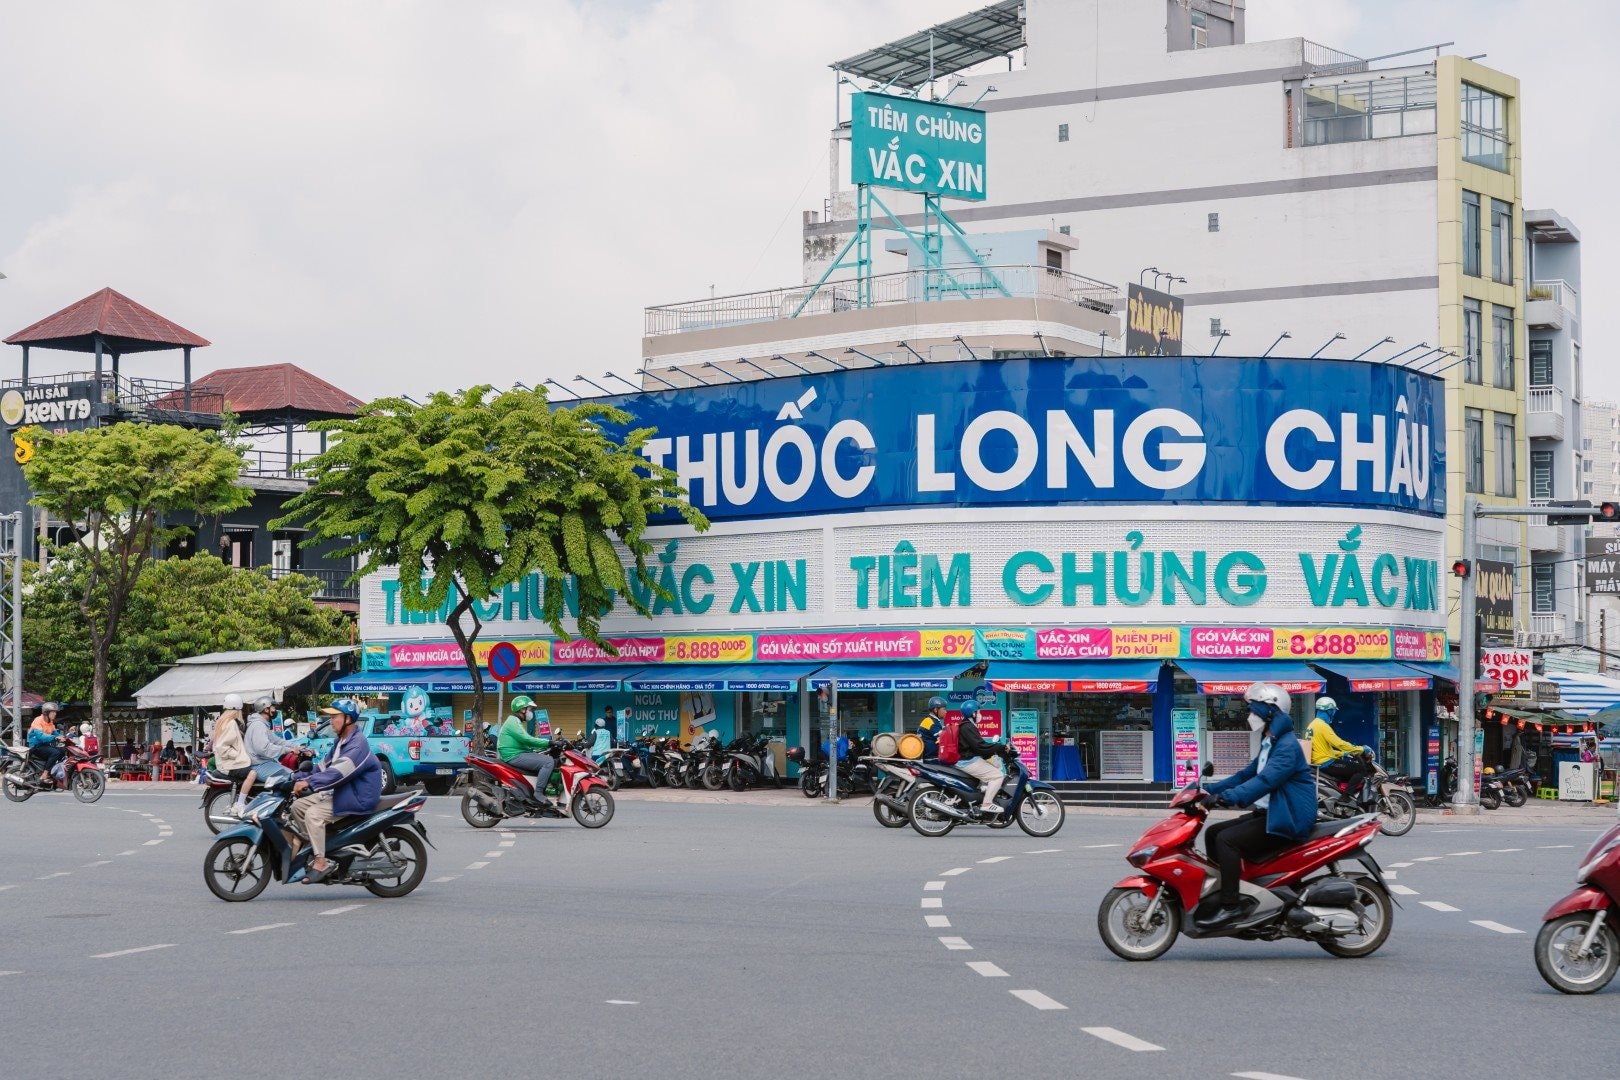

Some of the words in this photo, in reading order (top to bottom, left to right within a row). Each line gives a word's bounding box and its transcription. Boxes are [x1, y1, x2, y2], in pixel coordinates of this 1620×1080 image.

[868, 104, 908, 133] TIÊM
[915, 112, 983, 144] CHỦNG
[868, 135, 926, 184] VẮC
[937, 158, 983, 193] XIN
[642, 385, 877, 507] THUỐC
[917, 407, 1207, 492] LONG
[1265, 394, 1430, 501] CHÂU
[850, 539, 971, 609] TIÊM
[1001, 530, 1268, 607] CHỦNG
[1298, 524, 1399, 608] VẮC
[1404, 555, 1439, 611] XIN
[1588, 559, 1616, 573] MÁY
[627, 538, 715, 616] VẮC
[730, 558, 807, 614] XIN
[1039, 630, 1066, 644] VẮC
[1068, 633, 1090, 643] XIN
[1115, 630, 1148, 643] MIỄN
[1152, 631, 1173, 643] PHÍ
[1196, 631, 1219, 642] GÓI
[1220, 628, 1247, 642] VẮC
[1249, 632, 1270, 641] XIN
[558, 646, 574, 659] GÓI
[575, 643, 593, 659] VẮC
[639, 645, 659, 657] HPV
[761, 641, 778, 655] GÓI
[781, 639, 801, 655] VẮC
[803, 642, 820, 654] XIN
[823, 638, 842, 653] SỐT
[845, 636, 873, 653] XUẤT
[874, 635, 913, 652] HUYẾT
[942, 634, 974, 655] 8%
[1040, 644, 1077, 656] NGỪA
[1078, 643, 1109, 656] CÚM
[1115, 645, 1131, 655] 70
[1134, 643, 1158, 655] MŨI
[1196, 642, 1233, 655] NGỪA
[1235, 645, 1261, 655] HPV
[394, 649, 411, 663] VẮC
[412, 651, 426, 662] XIN
[427, 649, 448, 661] NGỪA
[528, 646, 545, 659] MŨI
[987, 650, 1023, 658] 10.10.25
[1493, 651, 1529, 667] QUÁN
[1005, 682, 1020, 690] KHIẾU
[1036, 681, 1050, 690] GÓP
[635, 709, 659, 721] UNG
